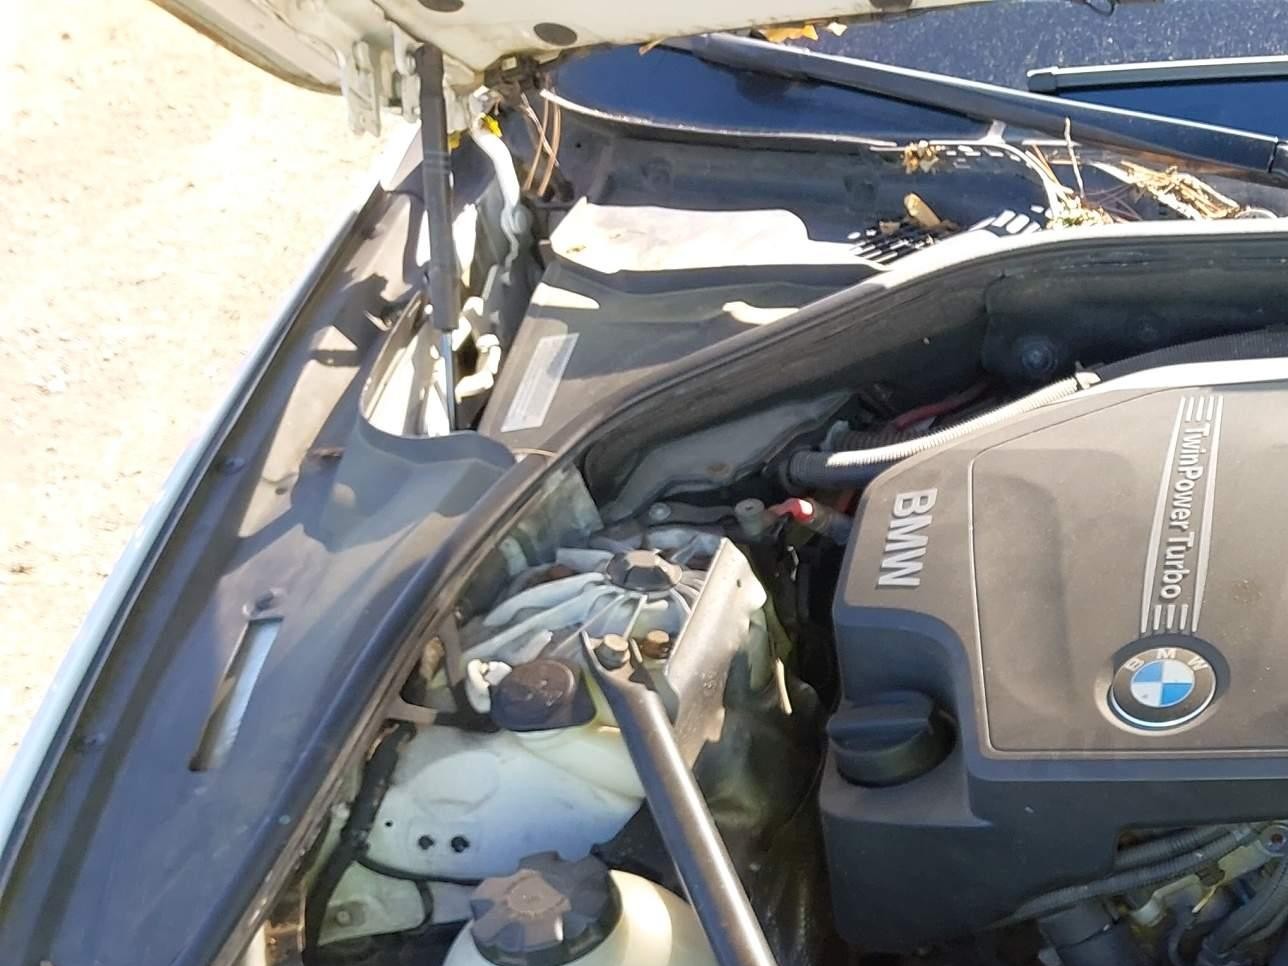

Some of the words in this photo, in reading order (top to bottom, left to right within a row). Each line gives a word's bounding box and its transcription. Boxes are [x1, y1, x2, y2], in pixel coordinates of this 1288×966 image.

[1168, 424, 1207, 530] TwinPower
[878, 486, 938, 589] BMW
[1158, 531, 1195, 601] Turbo
[1125, 647, 1209, 671] BMW
